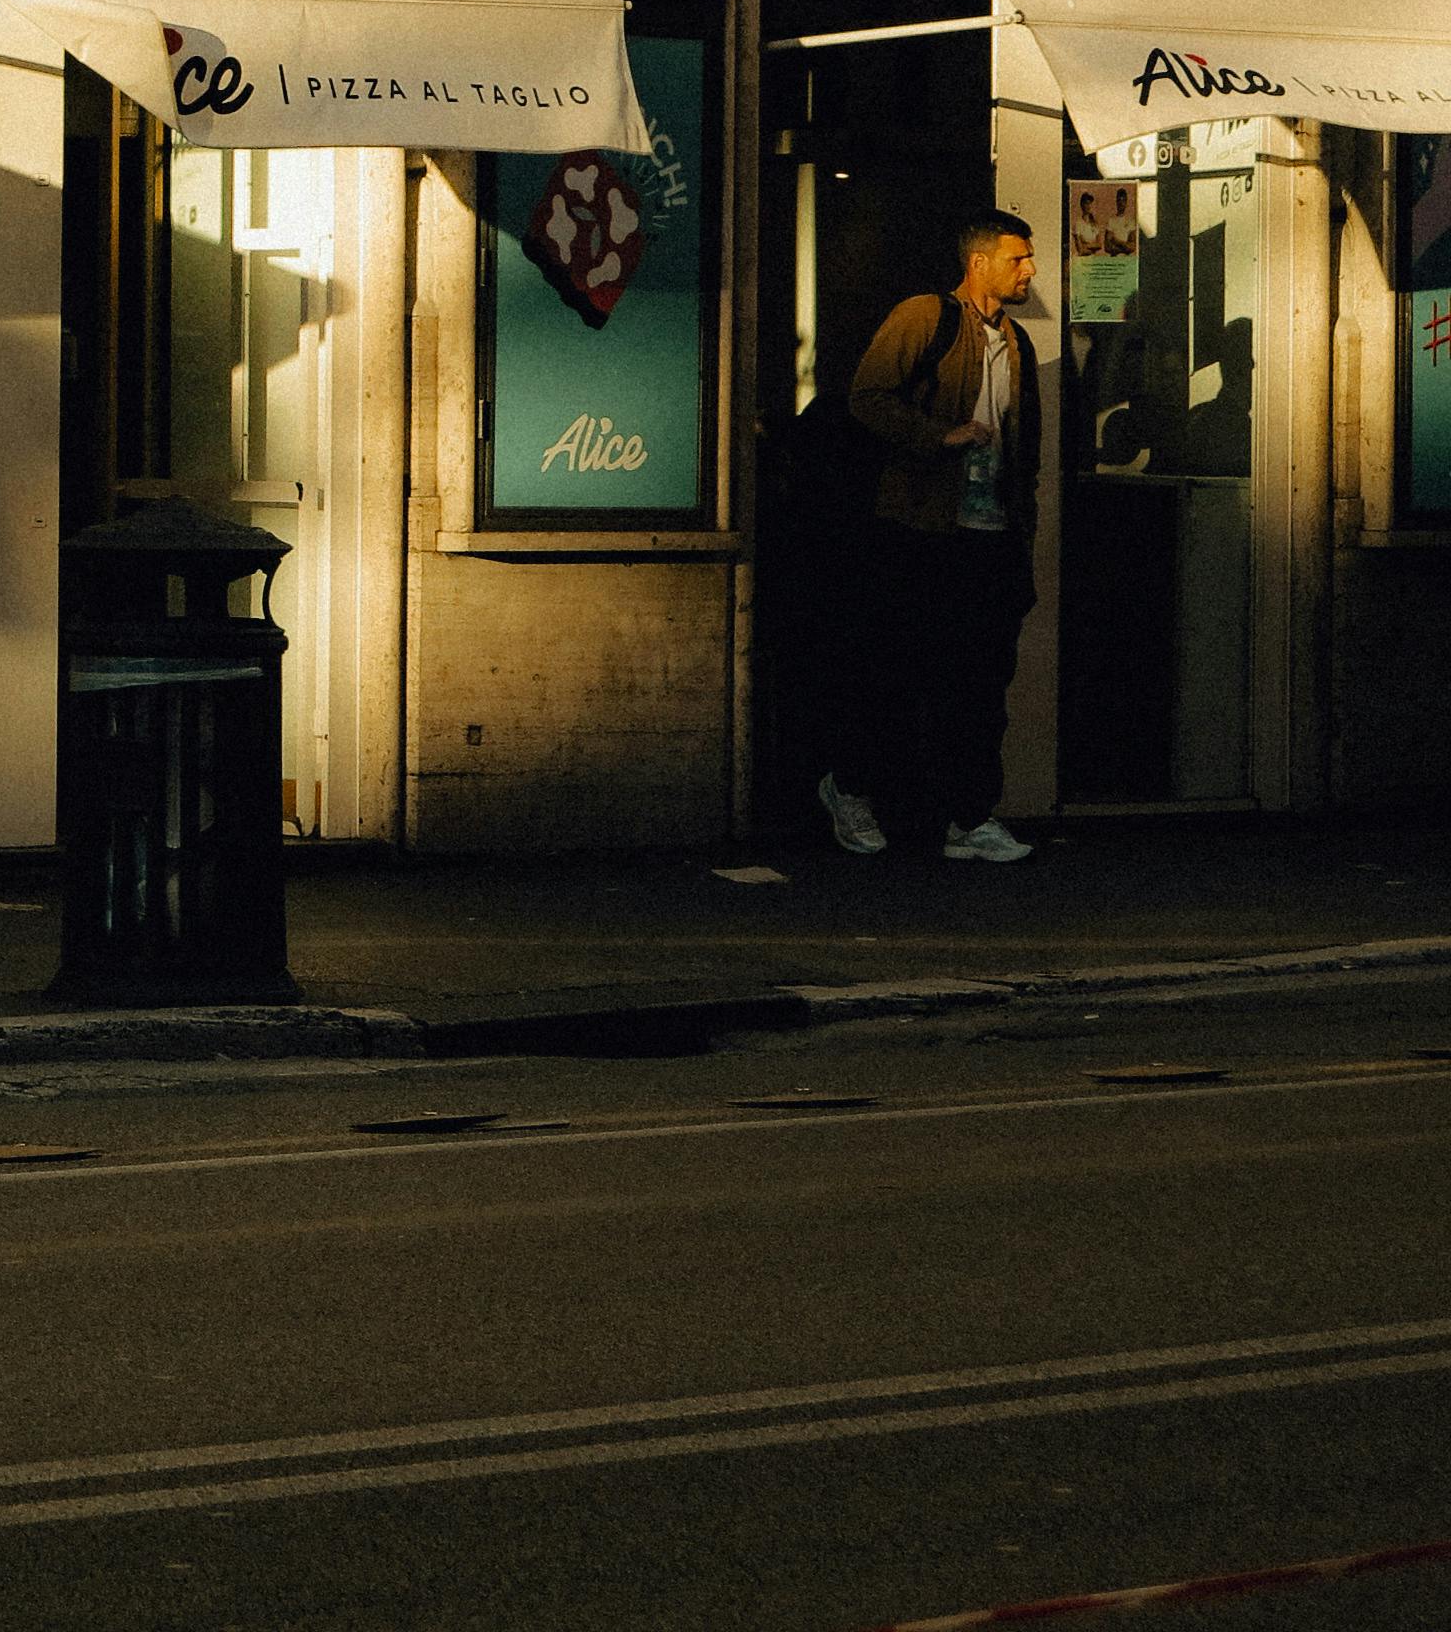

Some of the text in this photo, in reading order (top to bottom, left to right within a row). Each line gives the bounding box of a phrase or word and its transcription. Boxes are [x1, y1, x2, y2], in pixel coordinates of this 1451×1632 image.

[306, 76, 407, 101] PIZZA
[421, 80, 459, 104] AL
[470, 83, 591, 109] TAGLIO
[1131, 47, 1287, 107] Alice
[1322, 83, 1407, 104] PIZZA
[540, 413, 649, 473] Alice
